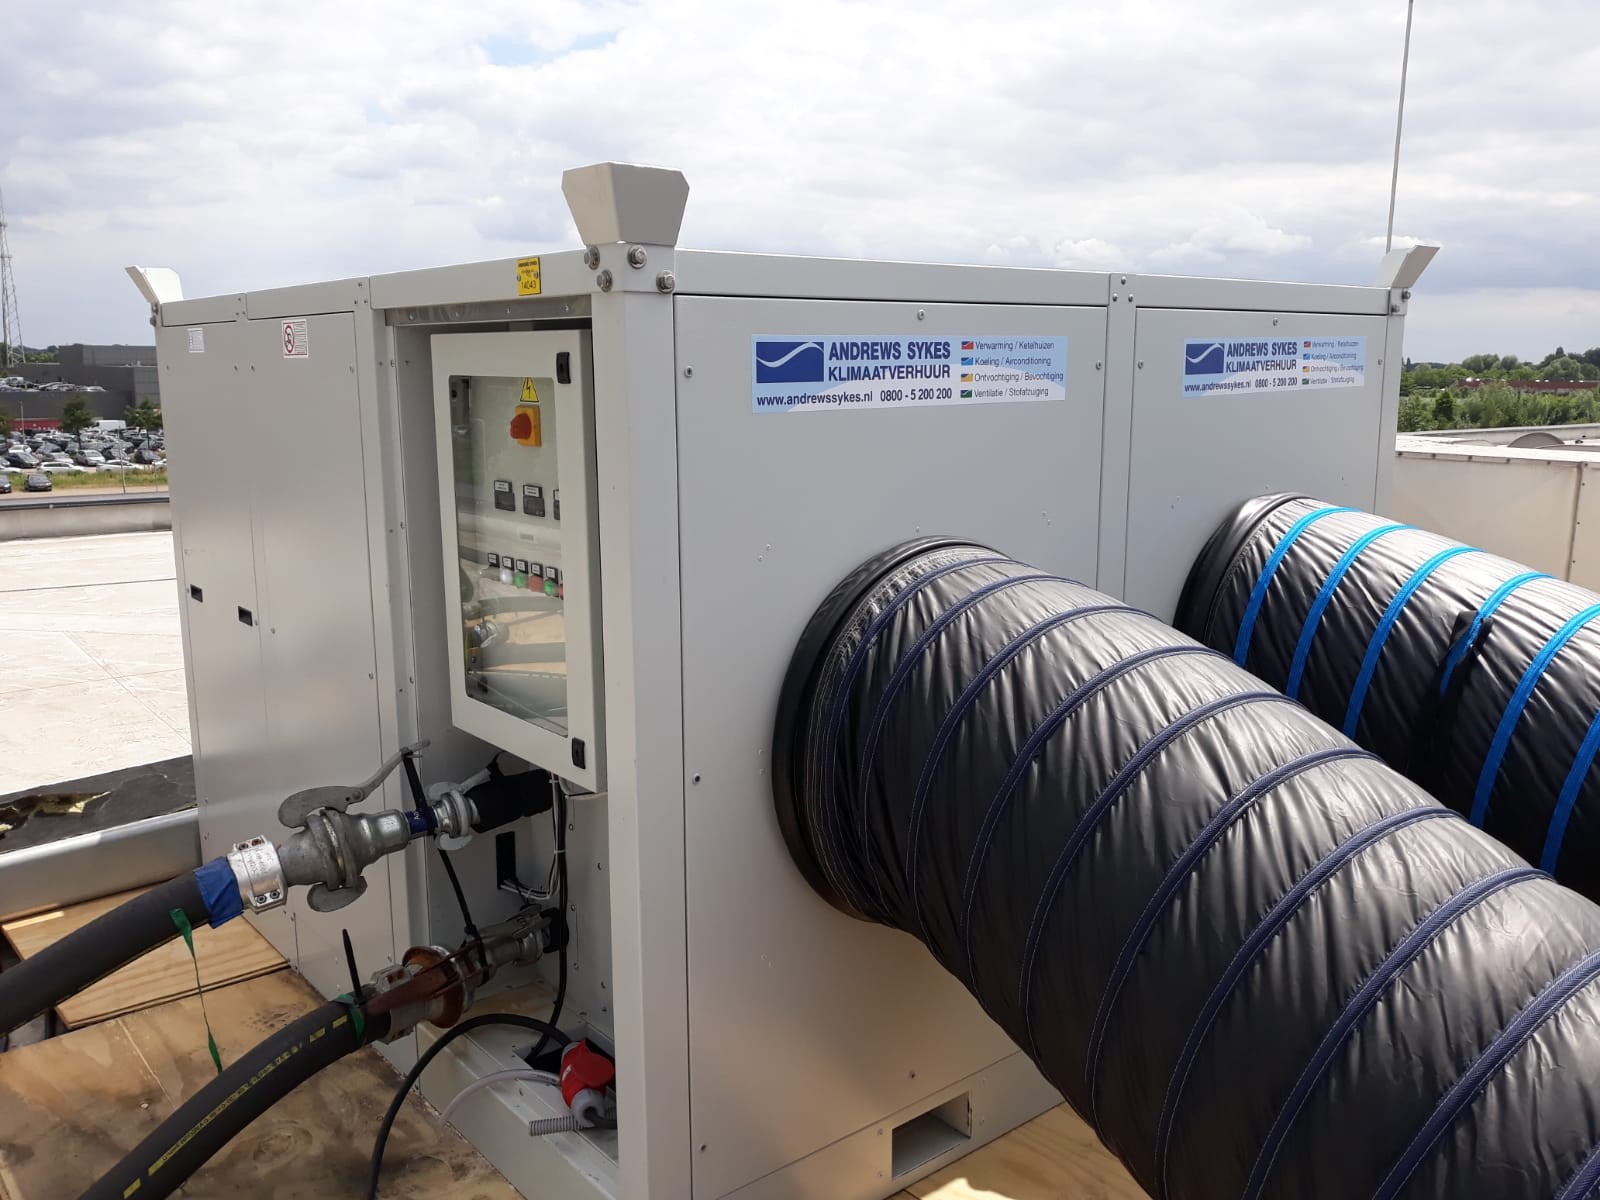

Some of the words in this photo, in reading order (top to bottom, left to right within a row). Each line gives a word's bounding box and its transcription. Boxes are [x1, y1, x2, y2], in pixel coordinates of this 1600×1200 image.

[828, 341, 902, 361] ANDREWS
[907, 341, 951, 360] SYKES
[975, 341, 1013, 351] Verwarming
[1019, 341, 1055, 350] Ketelhuizen
[1226, 342, 1269, 358] ANDREWS
[1271, 341, 1298, 356] SYKES
[975, 357, 999, 367] Koeling
[1005, 356, 1051, 367] Airconditioning
[1226, 359, 1297, 373] KLIMAATVERHUUR
[828, 364, 951, 382] KLIMAATVERHUUR
[974, 372, 1019, 383] Ontvochtiging
[1024, 371, 1064, 382] Bevochtiging
[1184, 380, 1251, 392] www.andrewssykes.nl
[756, 390, 873, 406] www.andrewssykes.nl
[880, 389, 903, 402] 0800
[911, 389, 916, 400] 5
[918, 388, 934, 400] 200
[936, 387, 952, 400] 200
[974, 388, 1003, 398] Ventilatie
